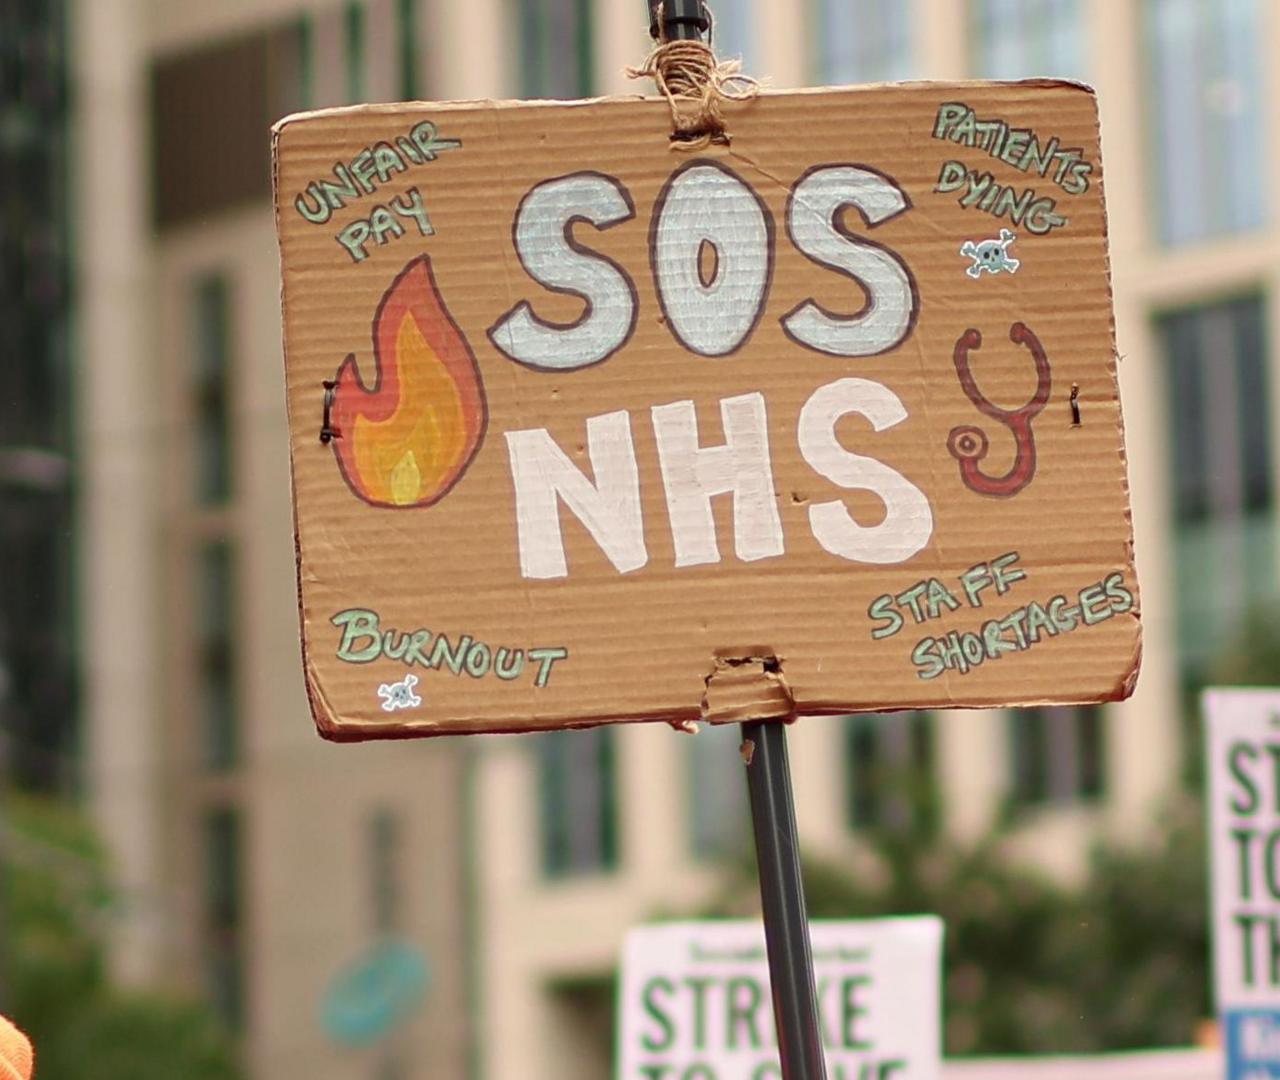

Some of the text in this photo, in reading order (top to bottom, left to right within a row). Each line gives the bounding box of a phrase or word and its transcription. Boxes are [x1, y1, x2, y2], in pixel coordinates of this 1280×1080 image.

[295, 120, 462, 225] UNFAIR
[932, 102, 1091, 197] PATIENTS
[336, 188, 435, 262] PAY
[936, 161, 1068, 235] DYING
[486, 158, 918, 373] SOS
[504, 377, 935, 578] NHS
[868, 552, 1025, 641] STAFF
[912, 573, 1134, 680] SHORTAGES
[332, 609, 566, 688] BURNOUT
